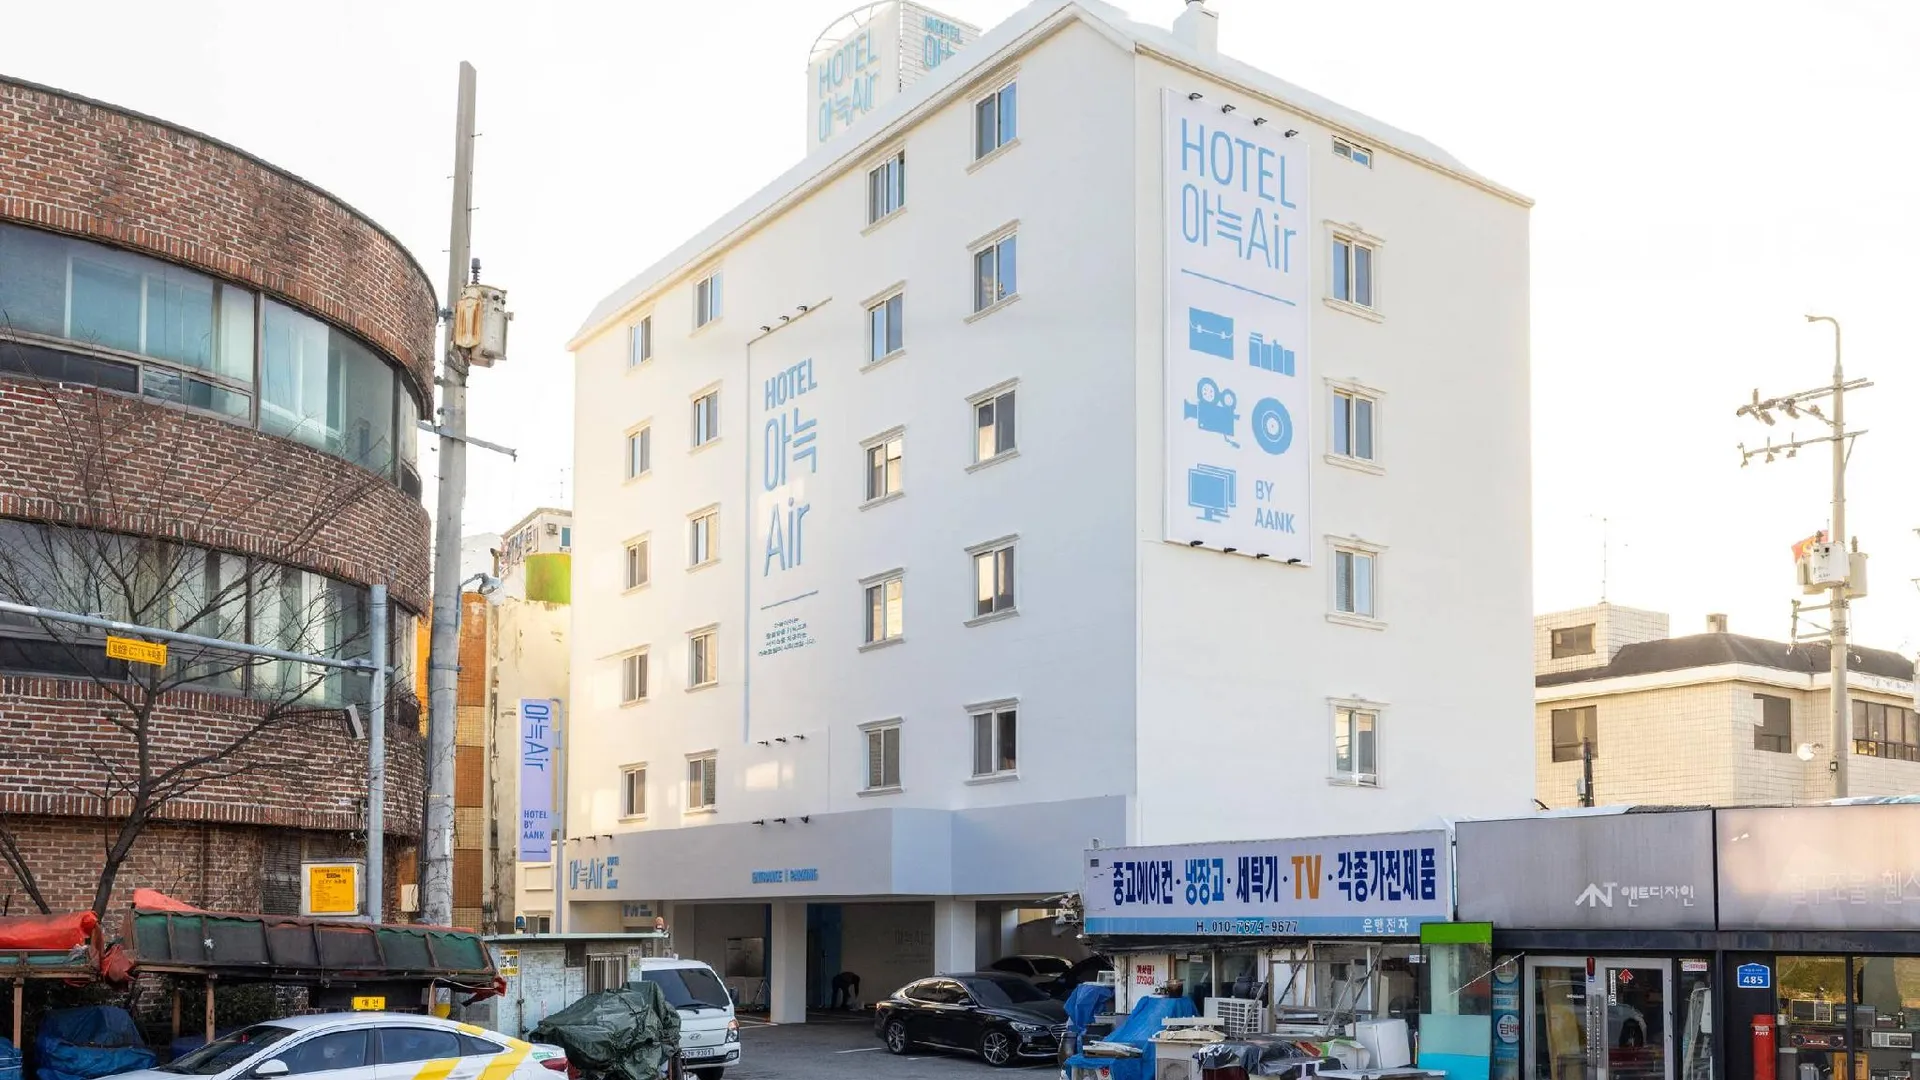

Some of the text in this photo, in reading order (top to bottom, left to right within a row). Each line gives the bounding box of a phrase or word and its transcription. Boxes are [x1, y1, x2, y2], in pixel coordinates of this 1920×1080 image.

[818, 28, 880, 98] HOTEL
[1182, 117, 1297, 210] HOTEL
[1182, 183, 1297, 273] 아늑Air
[764, 357, 818, 411] HOTEL
[764, 407, 818, 492] 아늑
[1255, 479, 1275, 502] BY
[764, 497, 810, 577] Air
[1254, 507, 1296, 534] AANK
[524, 703, 549, 772] 아늑Air
[524, 809, 548, 820] HOTEL
[524, 820, 534, 830] BY
[523, 830, 546, 840] AANK
[1113, 848, 1436, 906] 중고에어컨 냉장고 세탁기 TV 각종가전제품
[1621, 885, 1694, 907] 앤트디자인
[1362, 917, 1409, 933] 은행전자
[1743, 976, 1764, 985] 485
